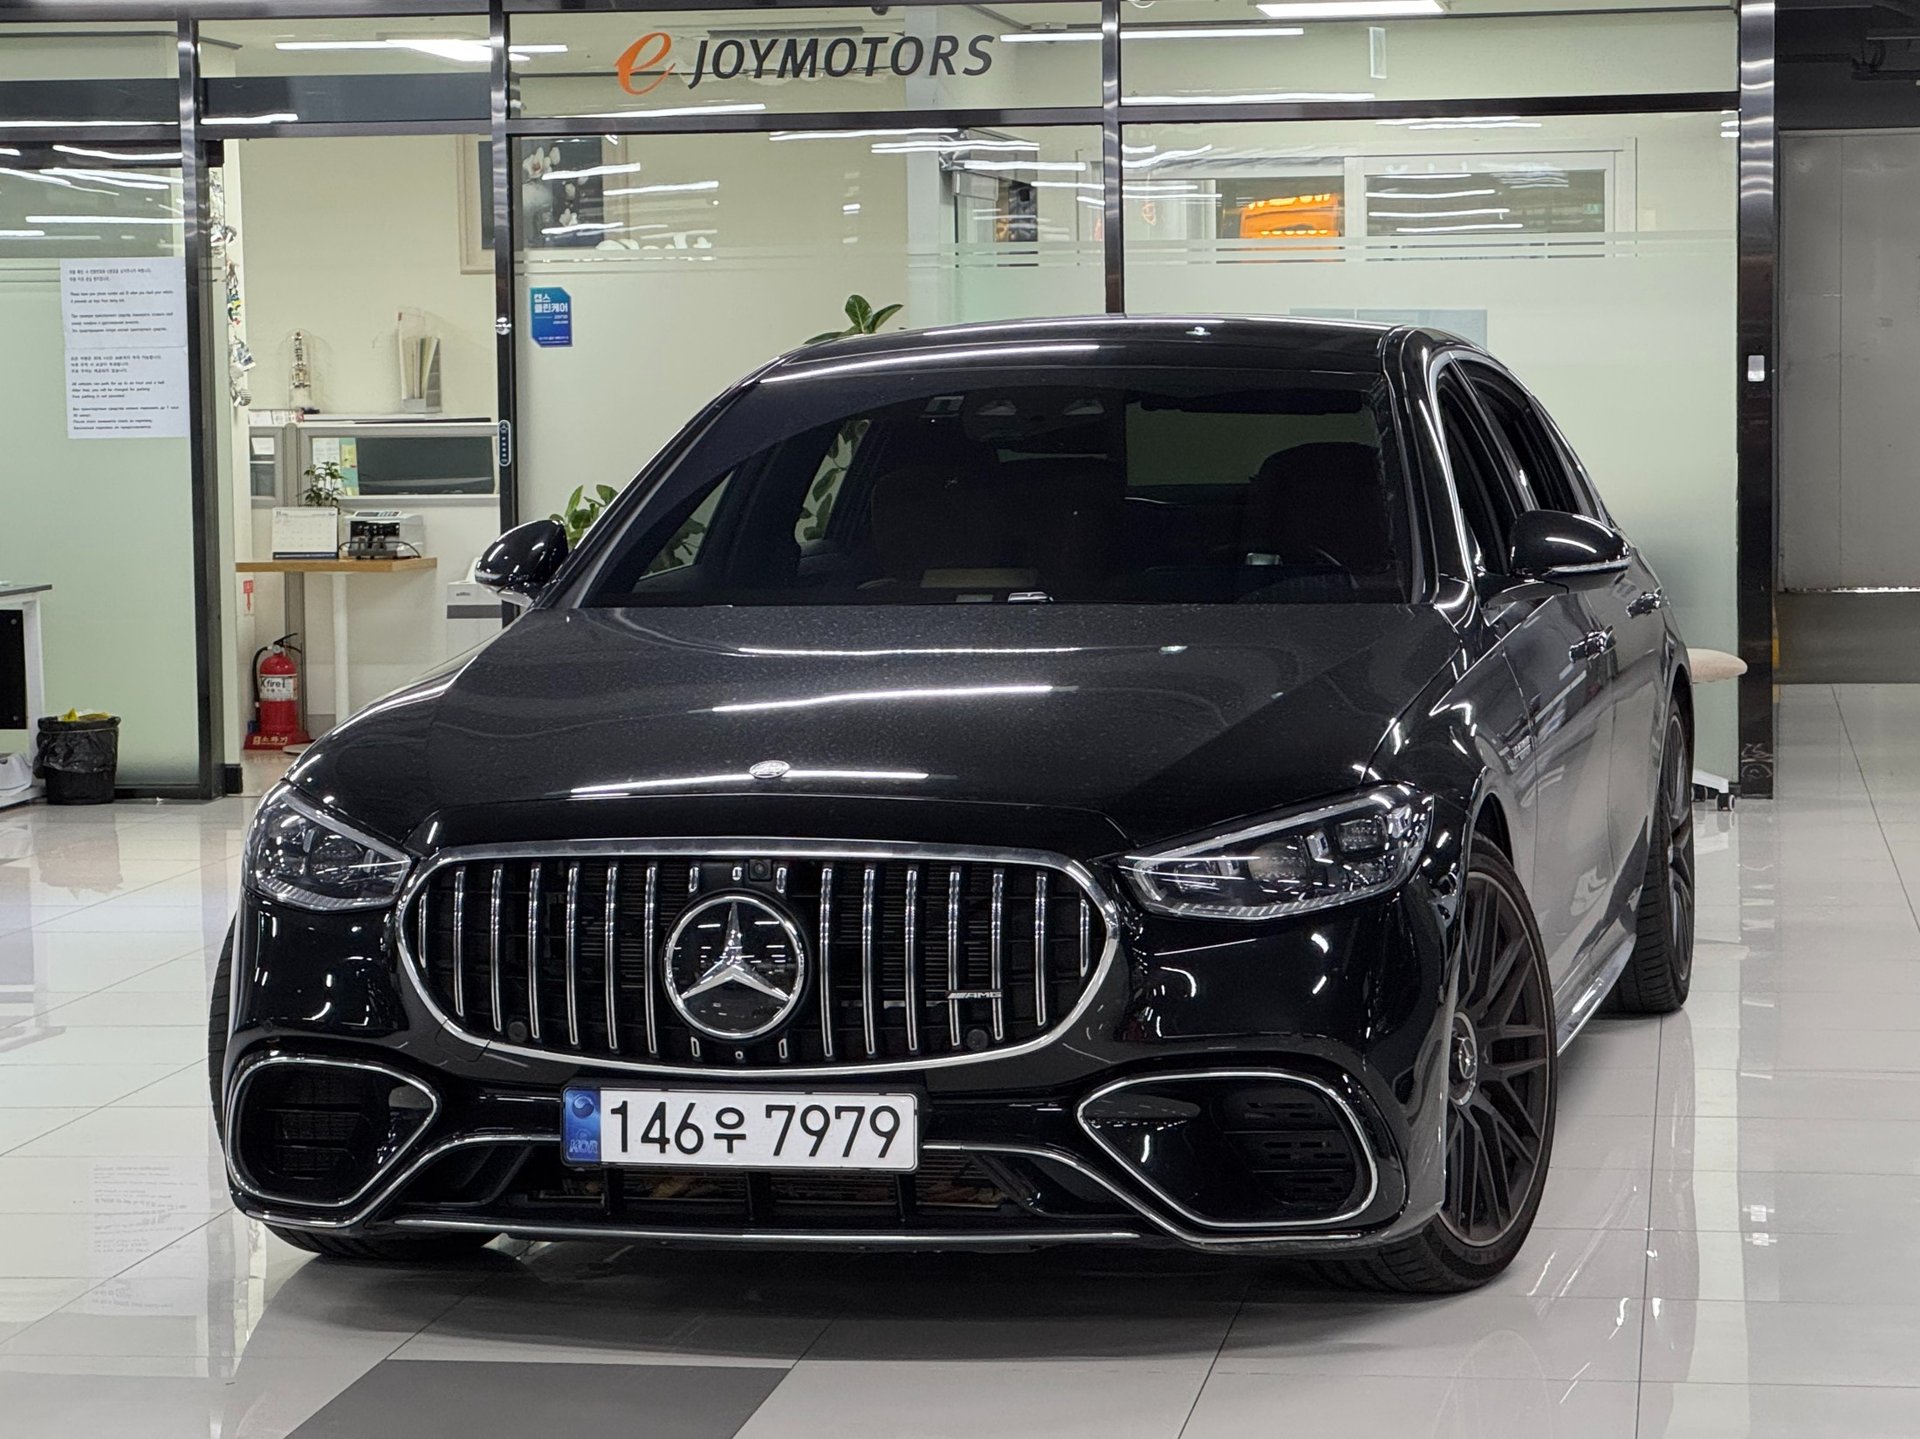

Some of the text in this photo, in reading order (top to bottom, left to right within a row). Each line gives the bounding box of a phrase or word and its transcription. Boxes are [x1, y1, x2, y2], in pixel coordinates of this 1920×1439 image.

[688, 34, 995, 90] JOYMOTORS
[963, 991, 1002, 999] AMG
[765, 1104, 901, 1158] 7979
